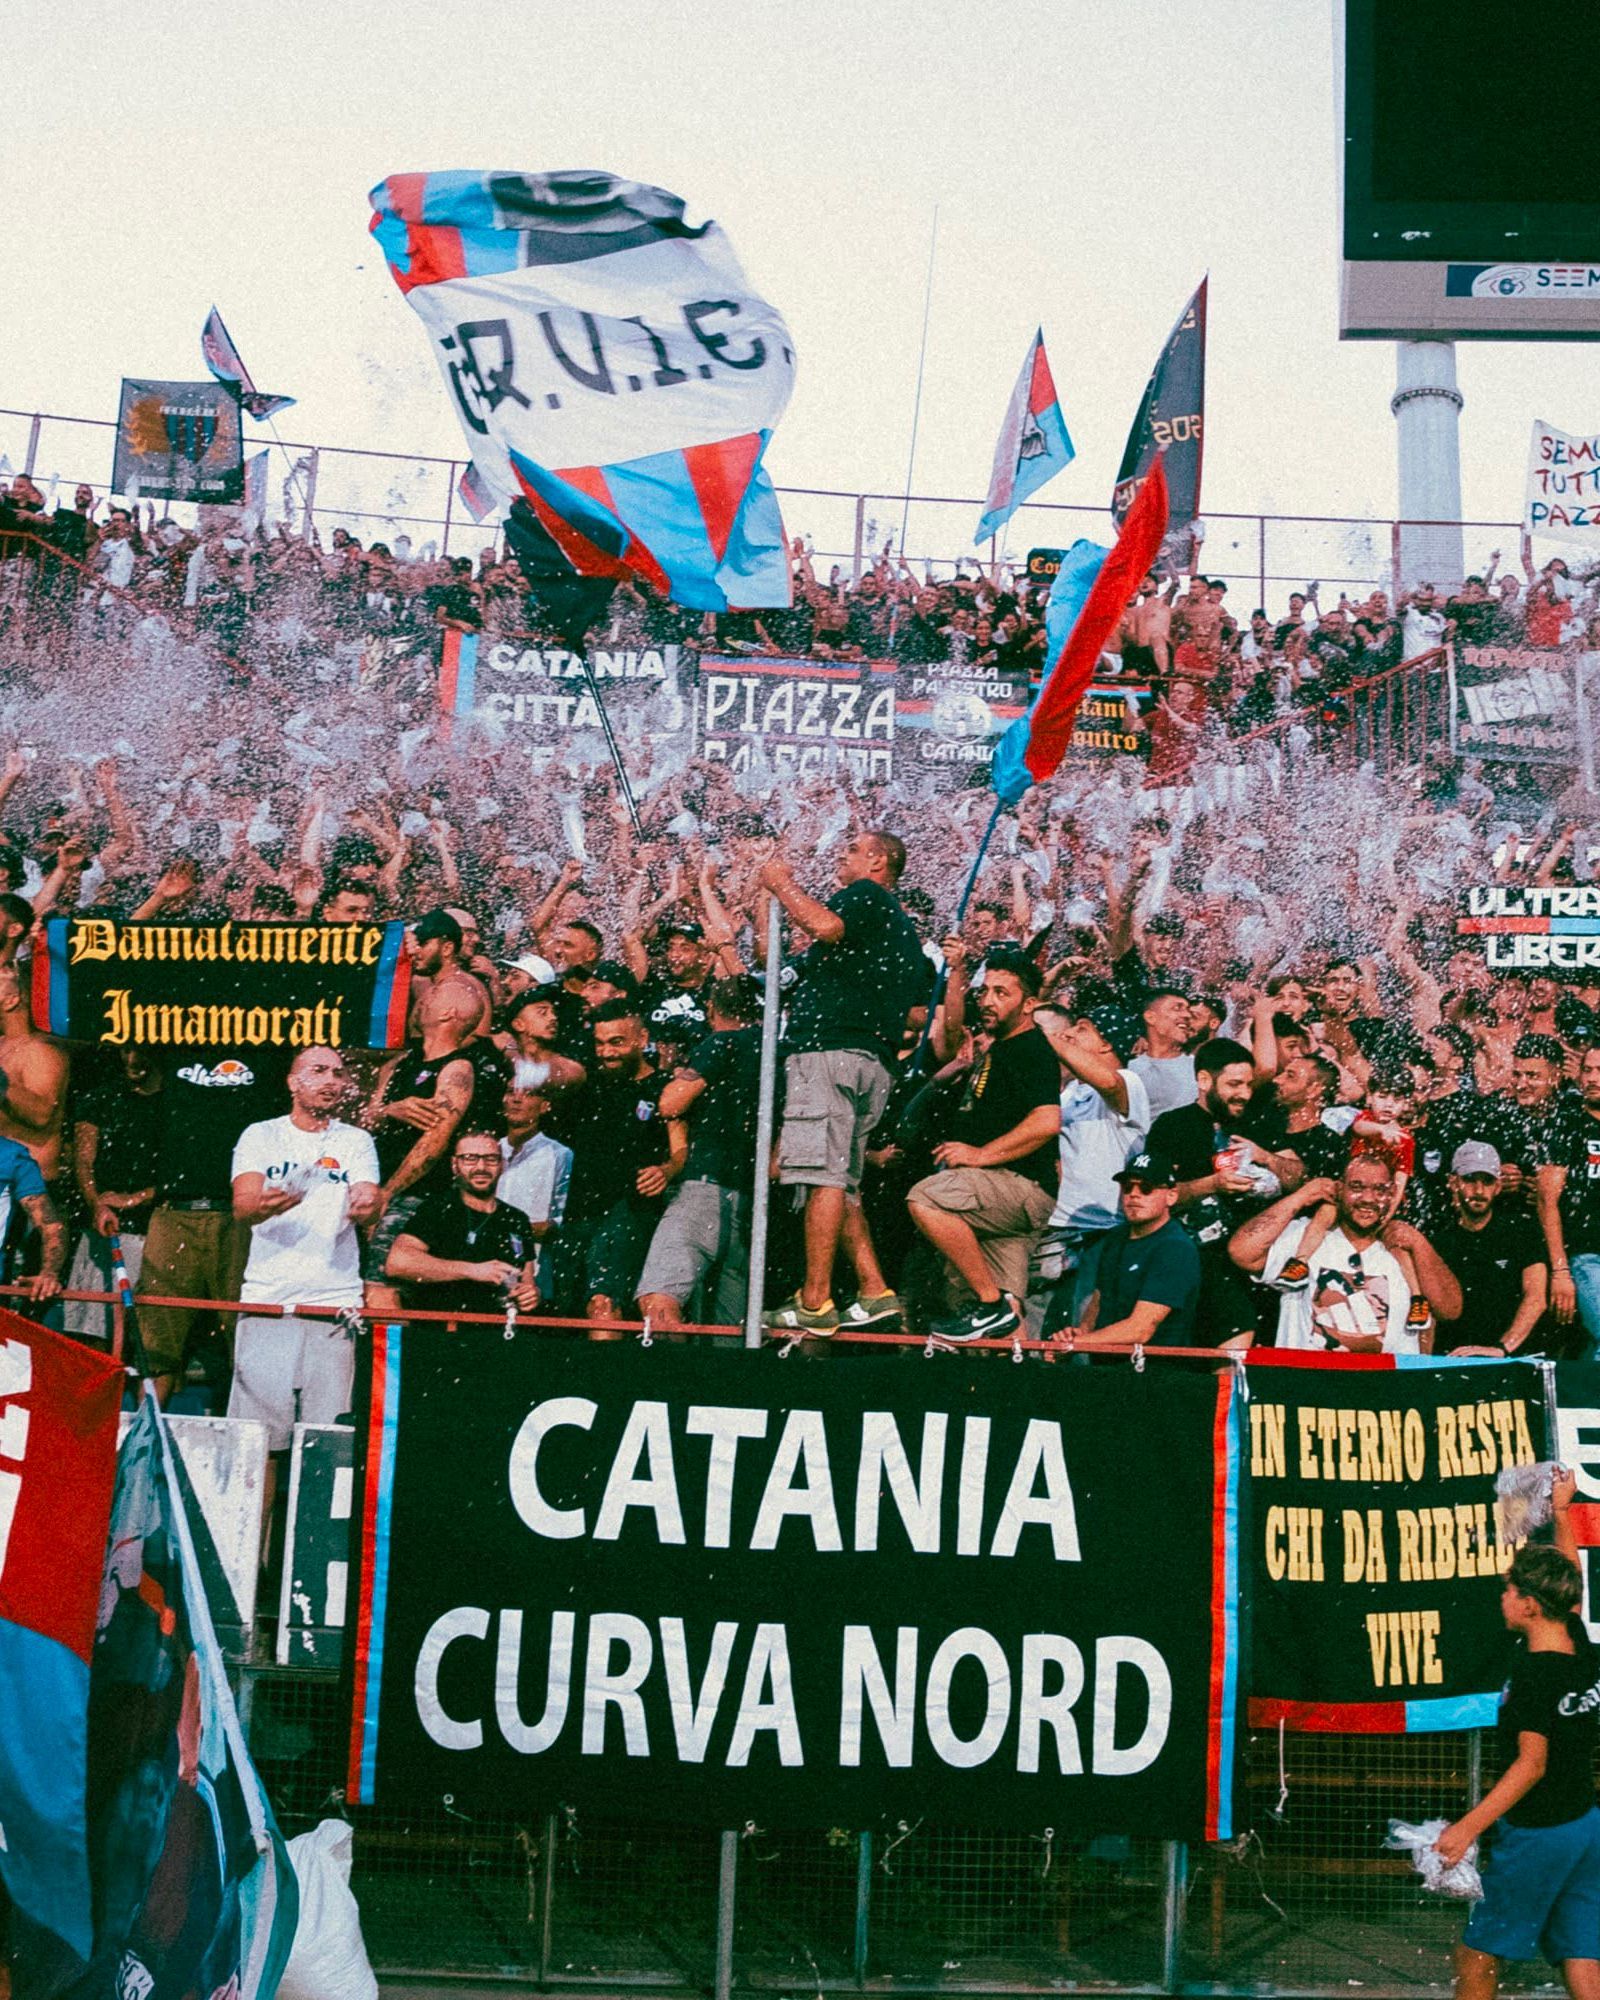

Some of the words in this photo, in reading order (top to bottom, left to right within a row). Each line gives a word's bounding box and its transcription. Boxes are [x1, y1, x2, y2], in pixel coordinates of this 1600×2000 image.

[488, 644, 667, 679] CATANIA
[927, 663, 999, 681] PIAZZA
[705, 676, 895, 740] PIAZZA
[1469, 887, 1600, 915] ULTRA
[69, 919, 382, 966] Dannatamente
[1487, 935, 1600, 967] LIBER
[101, 989, 344, 1047] Innamorati
[177, 1063, 255, 1087] ellesse
[1249, 1404, 1286, 1478] IN
[1298, 1406, 1425, 1482] ETERNO
[1437, 1399, 1536, 1478] RESTA
[508, 1396, 1082, 1562] CATANIA
[1265, 1505, 1324, 1583] CHI
[1342, 1509, 1388, 1583] DA
[1396, 1503, 1527, 1582] RIBELL
[1366, 1610, 1443, 1688] VIVE
[414, 1606, 804, 1767] CURVA
[839, 1624, 1172, 1775] NORD
